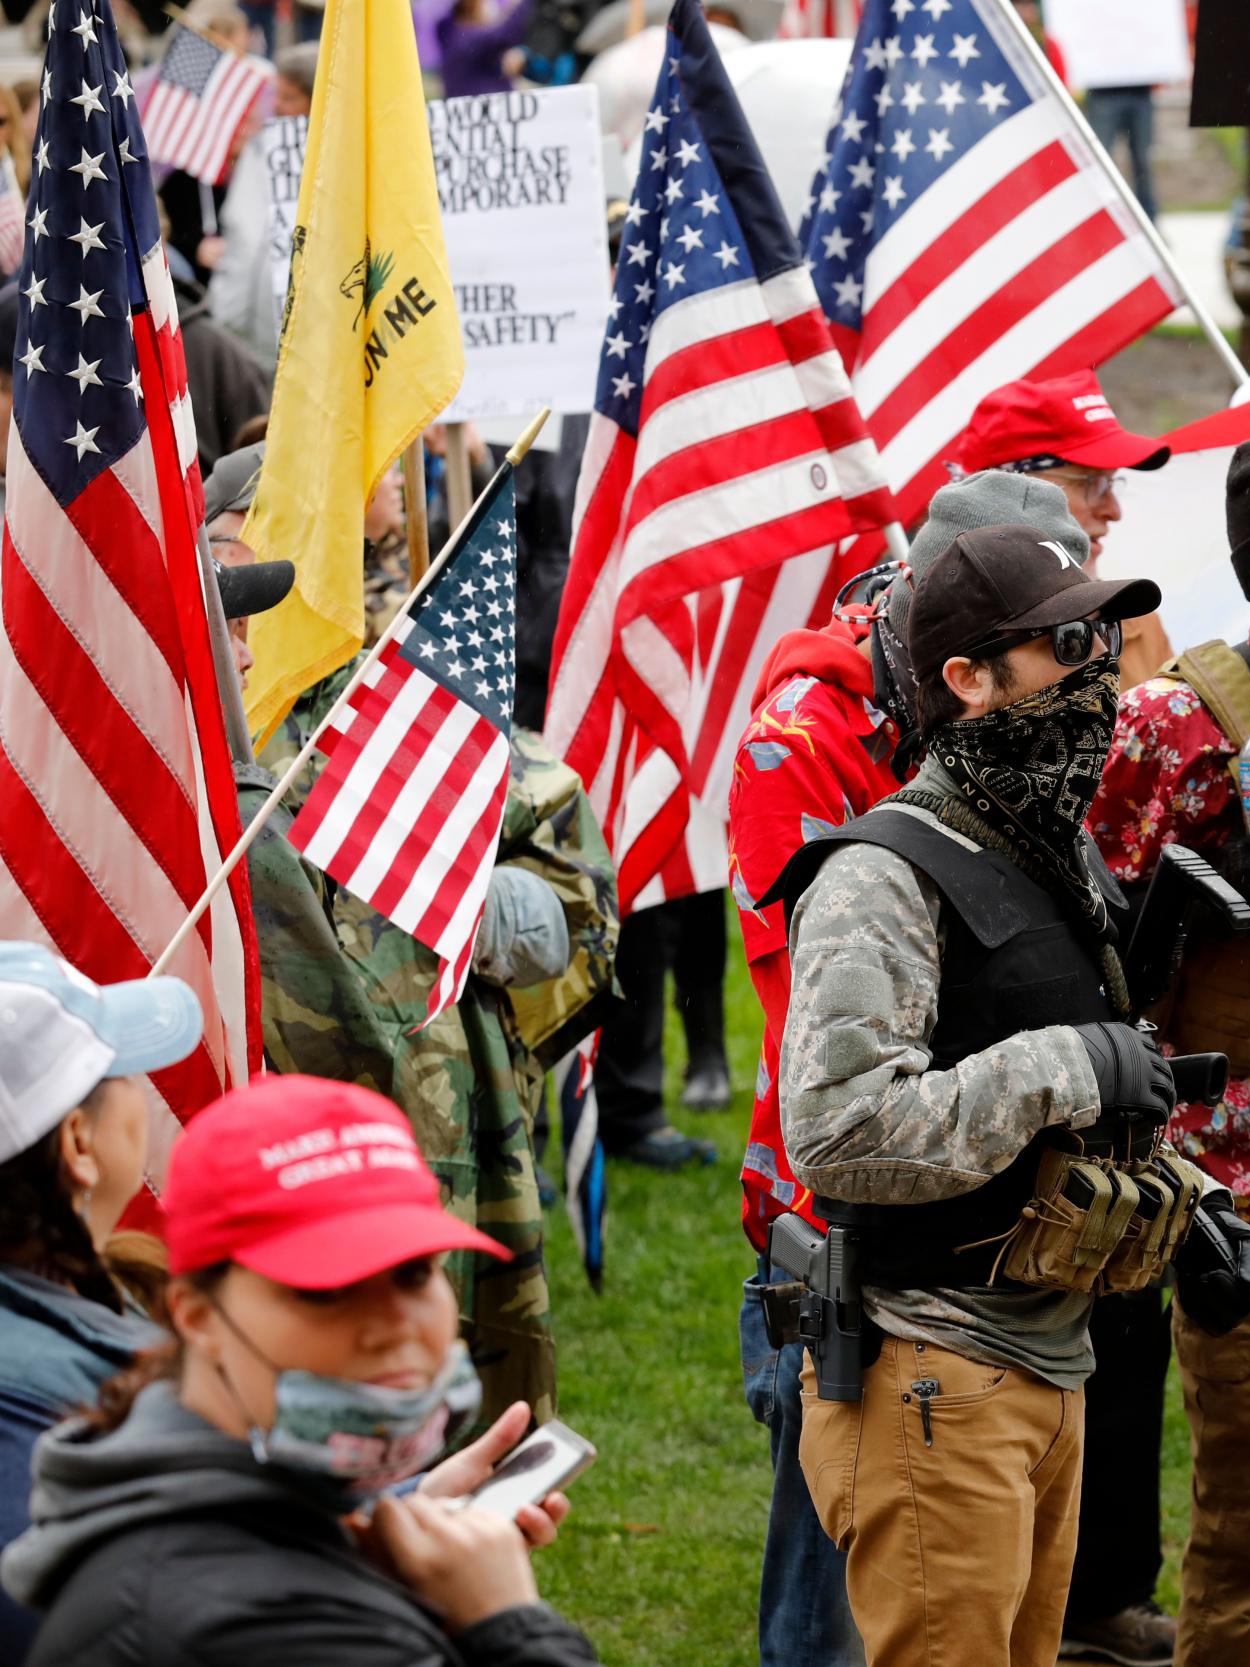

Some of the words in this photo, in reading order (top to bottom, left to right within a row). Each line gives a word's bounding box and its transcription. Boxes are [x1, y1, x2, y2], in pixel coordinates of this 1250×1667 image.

[446, 92, 538, 131] WOULD
[435, 146, 570, 186] PURCHASE
[384, 276, 437, 338] ME
